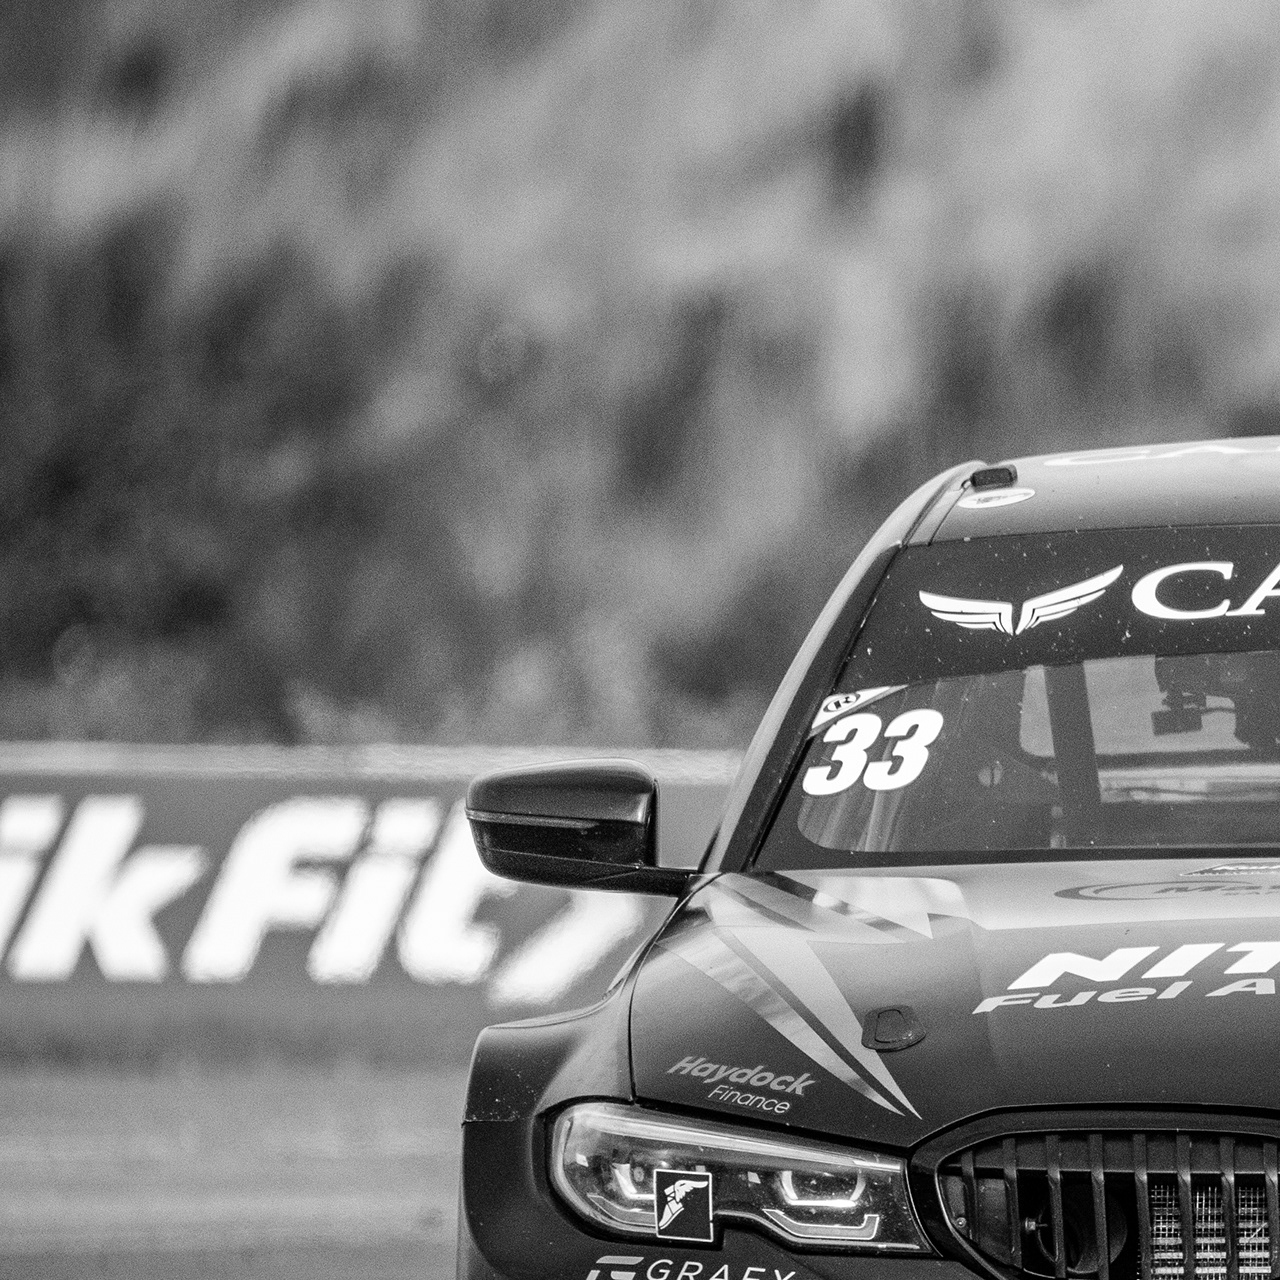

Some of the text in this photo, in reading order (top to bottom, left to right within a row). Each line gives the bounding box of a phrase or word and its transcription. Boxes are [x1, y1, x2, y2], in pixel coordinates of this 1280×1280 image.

[803, 708, 944, 796] 33
[971, 981, 1193, 1014] Fuel
[667, 1056, 816, 1096] Haydock
[707, 1085, 791, 1114] Finance
